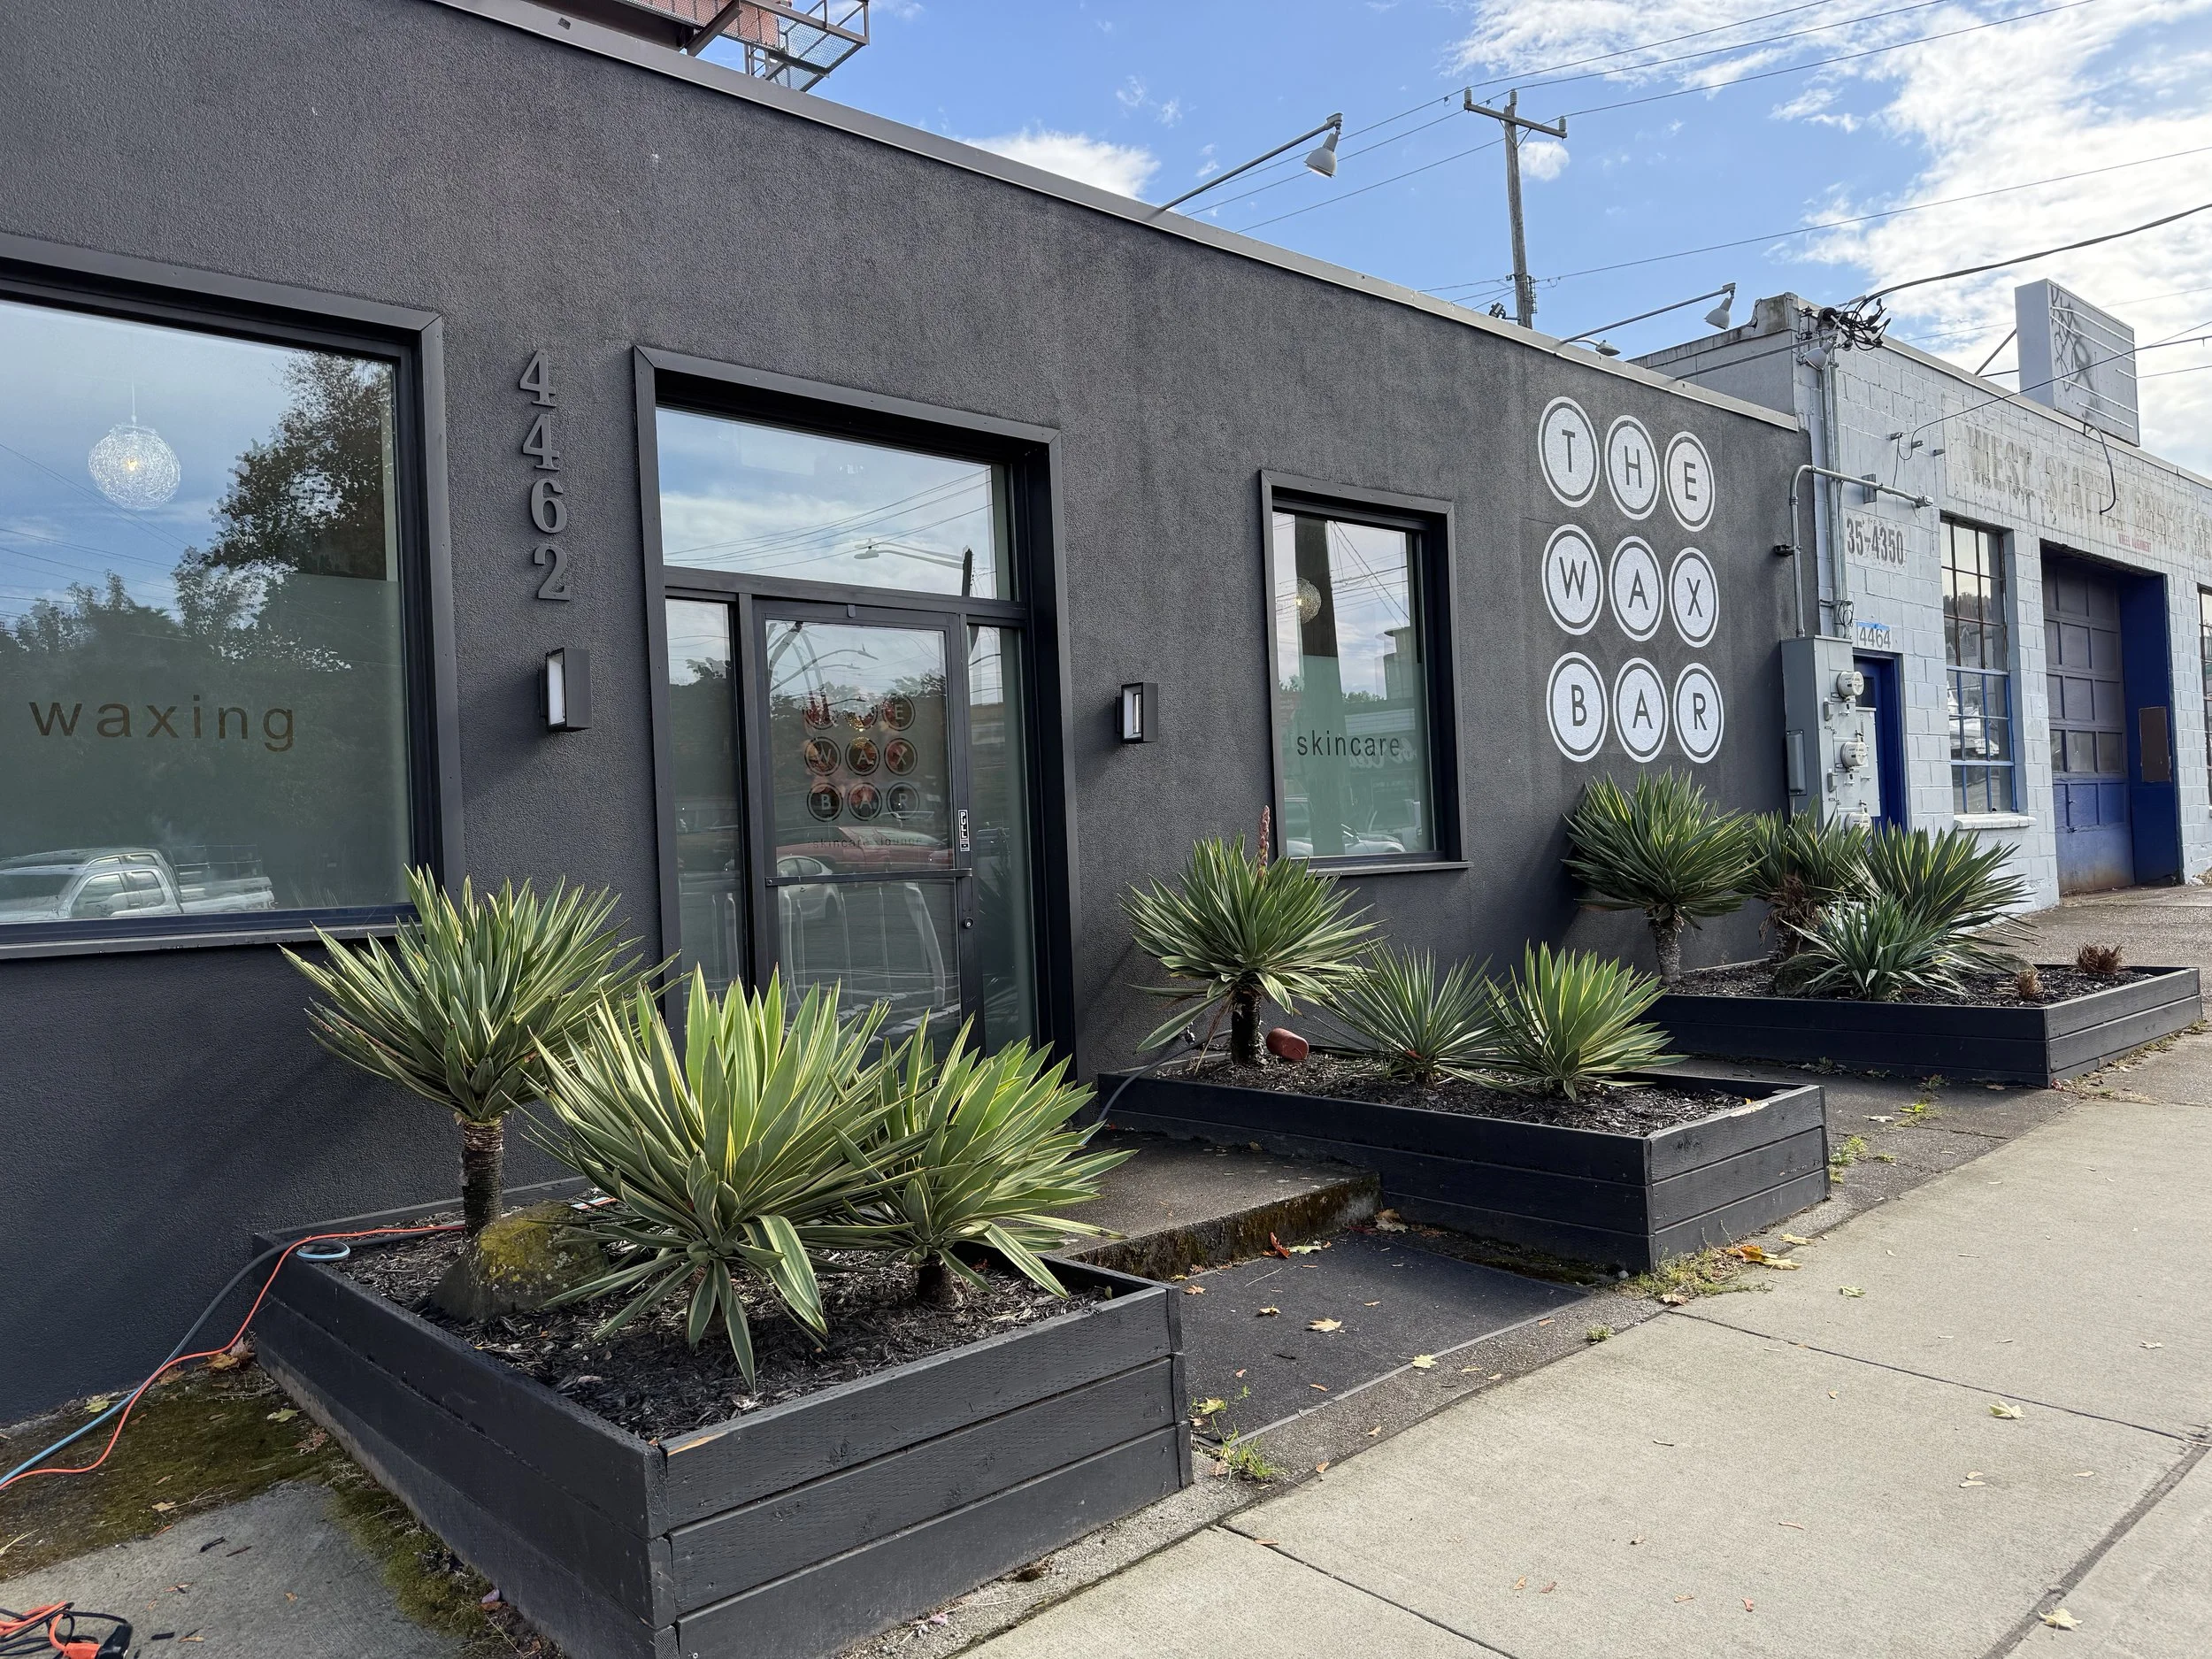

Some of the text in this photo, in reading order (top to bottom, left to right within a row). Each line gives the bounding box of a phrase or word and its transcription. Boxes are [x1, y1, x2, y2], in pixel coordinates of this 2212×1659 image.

[518, 349, 572, 603] 4462
[1847, 518, 1904, 565] 35-4350
[1859, 626, 1891, 649] 4464
[29, 694, 295, 752] waxing
[1297, 729, 1400, 756] skincare
